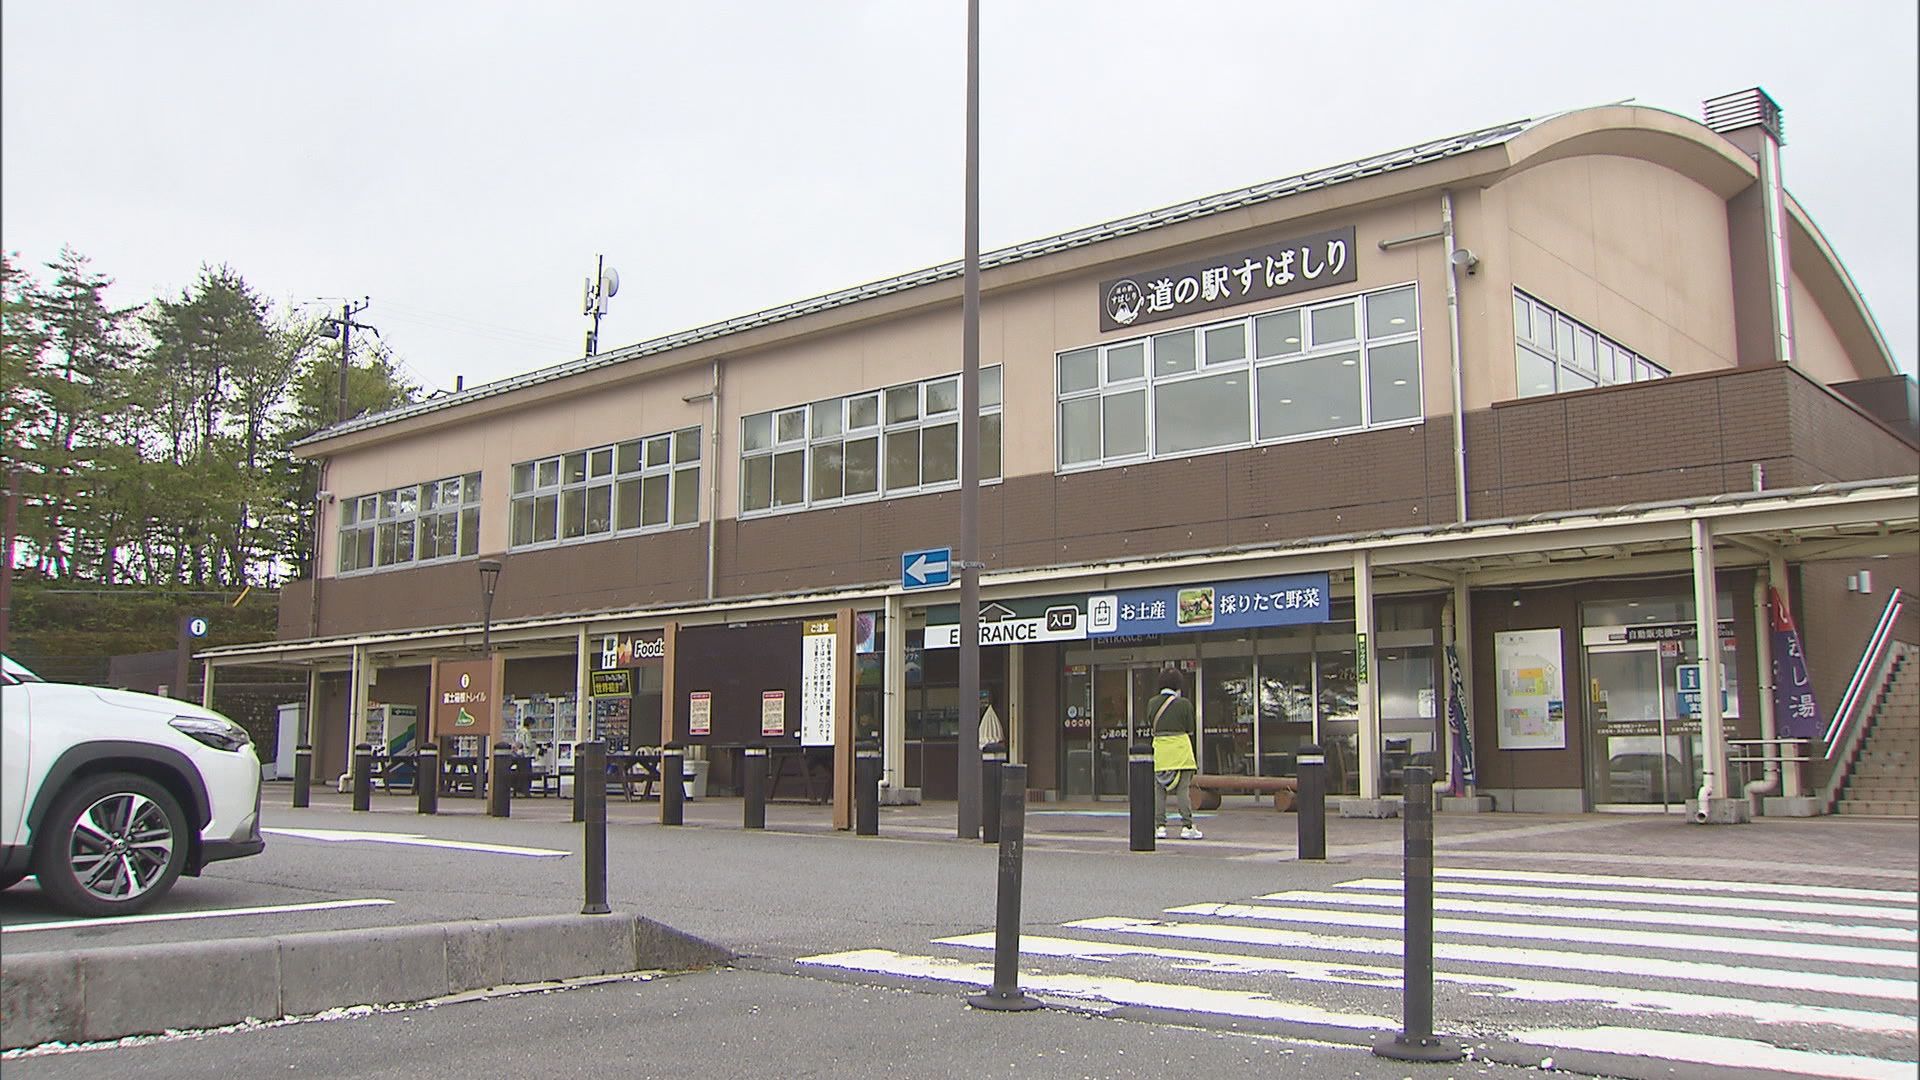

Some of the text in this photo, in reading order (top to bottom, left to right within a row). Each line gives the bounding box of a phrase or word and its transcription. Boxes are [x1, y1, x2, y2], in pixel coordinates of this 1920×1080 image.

[1147, 240, 1347, 314] 道の駅すばしり
[1121, 601, 1166, 620] お土産
[1219, 587, 1320, 615] 採りたて野菜
[1051, 612, 1073, 628] 入口
[949, 622, 1038, 645] ERANCE
[1629, 627, 1698, 640] 自動販売機コーナ
